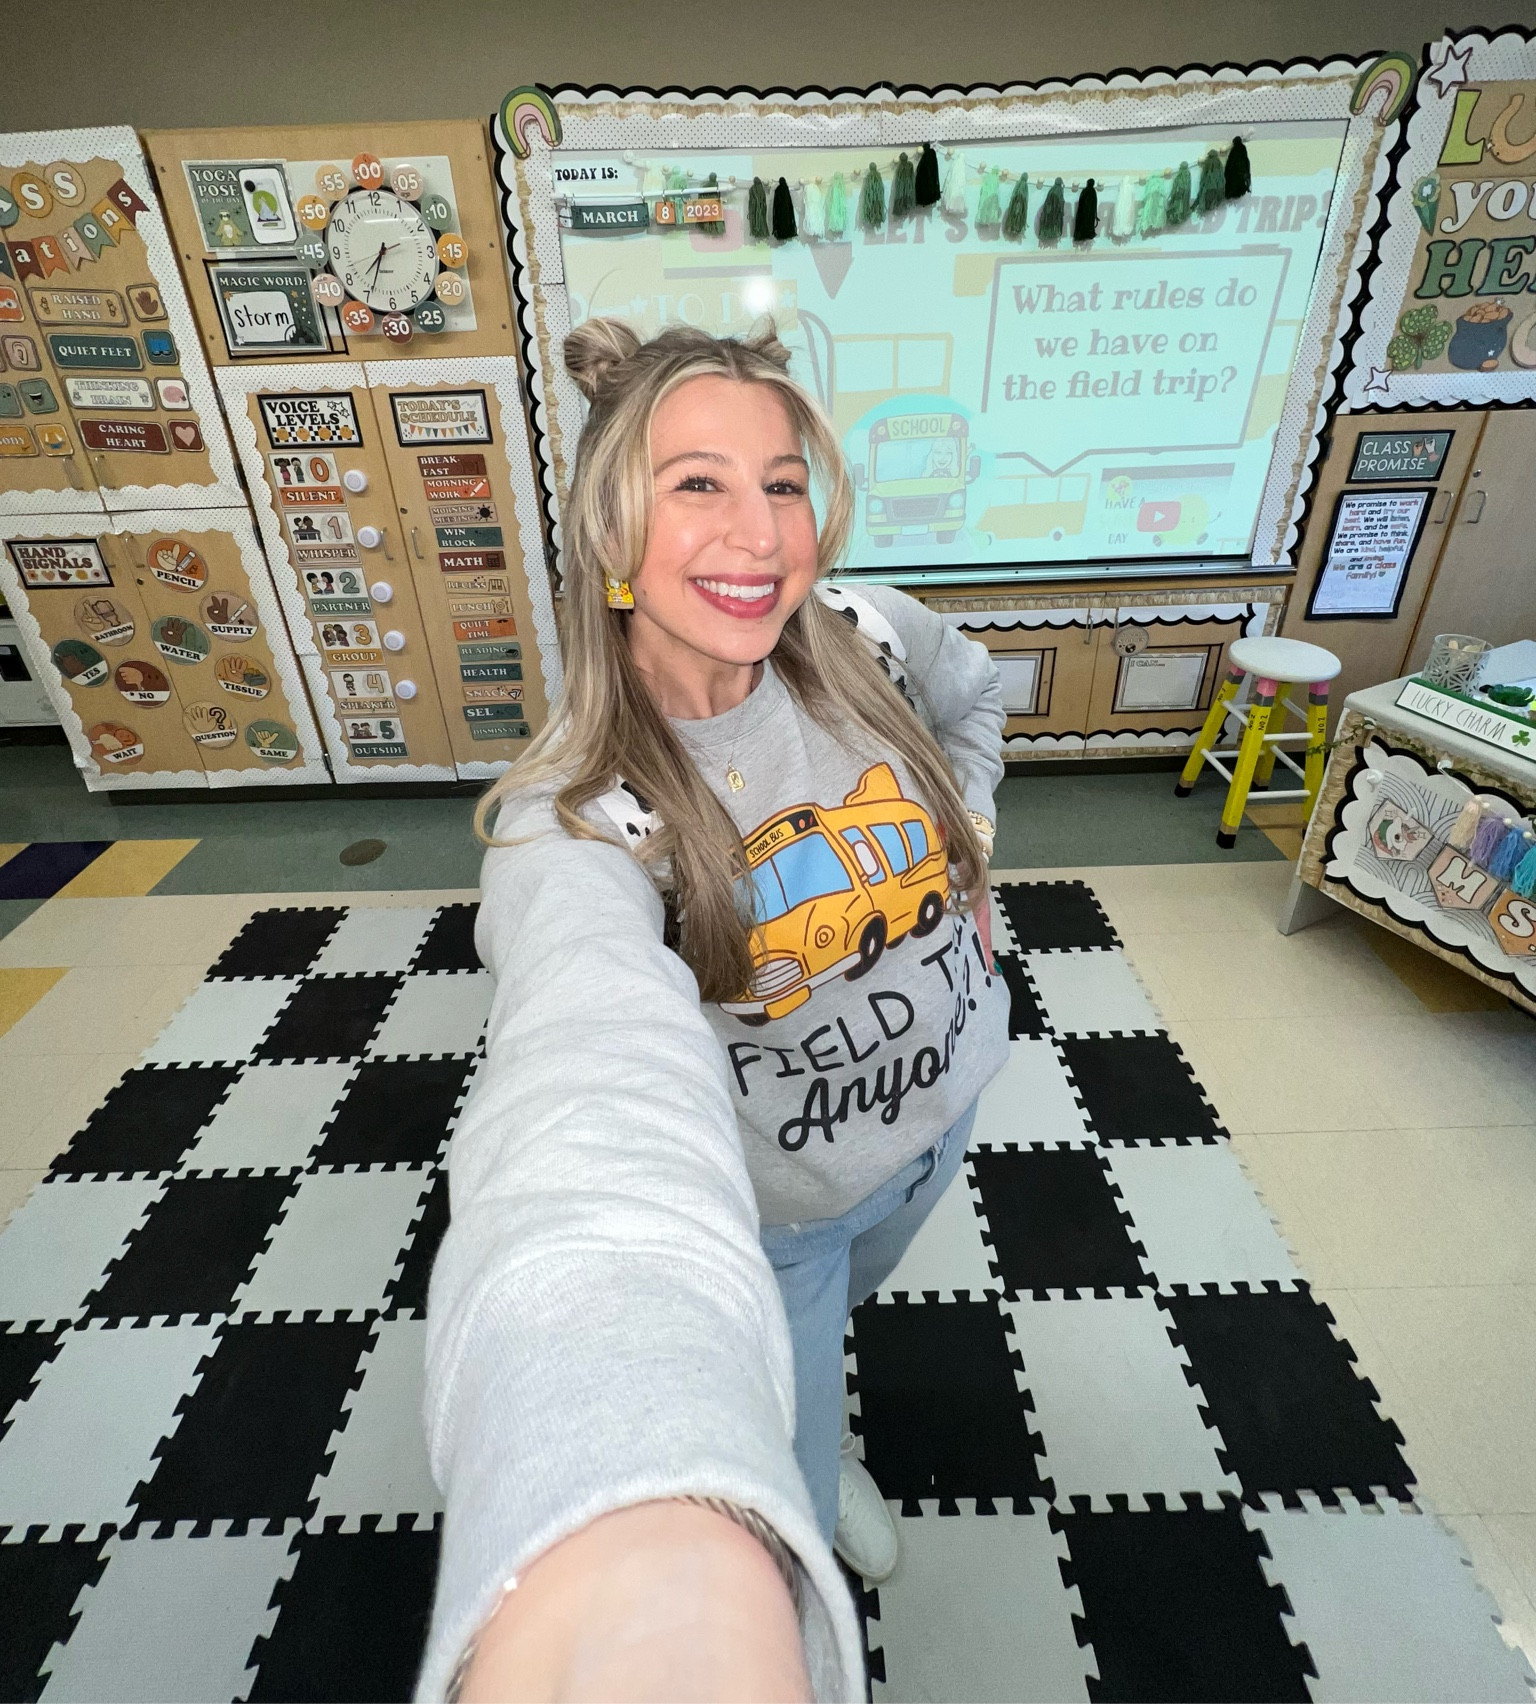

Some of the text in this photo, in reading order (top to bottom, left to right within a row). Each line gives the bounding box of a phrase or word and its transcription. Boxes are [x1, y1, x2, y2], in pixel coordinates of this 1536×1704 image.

[192, 169, 239, 182] YOGA
[354, 160, 381, 180] :00
[554, 167, 618, 182] TODAY IS:
[319, 174, 345, 191] :55
[393, 173, 418, 191] :05
[197, 184, 240, 197] POSE
[368, 191, 382, 206] 12
[300, 203, 327, 219] :50
[345, 200, 356, 214] 11
[396, 201, 402, 213] 1
[424, 203, 448, 220] :10
[582, 203, 720, 224] MARCH 8 2023
[0, 191, 132, 264] ations
[332, 219, 345, 232] 10
[417, 220, 425, 232] 2
[298, 245, 325, 261] :45
[332, 246, 341, 259] 9
[427, 245, 435, 259] 3
[441, 242, 464, 258] :15
[1414, 235, 1536, 300] HE
[219, 275, 307, 287] MAGIC WORD:
[345, 272, 354, 286] 8
[423, 272, 431, 285] 4
[313, 281, 342, 298] :40
[438, 280, 462, 297] :20
[51, 294, 102, 306] RAISED
[362, 290, 371, 303] 7
[410, 290, 419, 304] 5
[1012, 277, 1258, 315] What rules do
[389, 297, 397, 310] 6
[61, 309, 102, 320] HAND
[345, 309, 370, 326] :35
[416, 311, 443, 326] :25
[384, 320, 411, 337] :30
[1034, 328, 1219, 359] we have on
[58, 345, 132, 358] QUIET FEET
[1002, 366, 1239, 403] the field trip?
[265, 400, 321, 415] VOICE
[397, 399, 461, 413] TODAY'S
[275, 412, 341, 427] LEVELS
[399, 411, 478, 425] SCHEDULE
[98, 423, 146, 435] CARING
[891, 417, 947, 437] SCHOOL
[106, 437, 147, 449] HEART
[1363, 440, 1412, 456] CLASS
[309, 456, 331, 483] 0
[422, 467, 450, 476] FAST
[1357, 457, 1428, 472] PROMISE
[426, 478, 477, 488] MORNING
[286, 491, 338, 502] SILENT
[429, 491, 461, 500] WORK
[432, 505, 475, 515] MORNING
[326, 515, 343, 540] 1
[443, 528, 467, 537] WIN
[442, 538, 478, 548] BLOCK
[17, 547, 67, 559] HAND
[296, 548, 358, 560] WHISPER
[22, 557, 93, 570] SIGNALS
[443, 557, 484, 568] MATH
[156, 570, 200, 588] PENCIL
[338, 571, 361, 595] 2
[312, 601, 371, 614] PARTNER
[451, 602, 492, 613] LUNCH
[94, 625, 134, 642] BATHROOM
[211, 626, 254, 636] SUPPLY
[353, 623, 372, 647] 3
[160, 644, 201, 662] WATER
[332, 651, 378, 662] GROUP
[82, 667, 101, 680] YES
[463, 668, 507, 678] HEALTH
[223, 682, 263, 697] TISSUE
[366, 673, 384, 694] 4
[138, 691, 155, 701] NO
[466, 689, 509, 698] SNACK
[340, 700, 396, 710] SPEAKER
[466, 707, 494, 717] SEL
[1410, 689, 1508, 741] LUCKY CHARM
[194, 729, 236, 742] QUESTION
[379, 720, 396, 741] 5
[113, 748, 138, 761] WAIT
[259, 748, 289, 759] SAME
[354, 746, 404, 756] OUTSIDE
[749, 828, 784, 858] SCHOOL BUS
[727, 990, 915, 1097] FIELD
